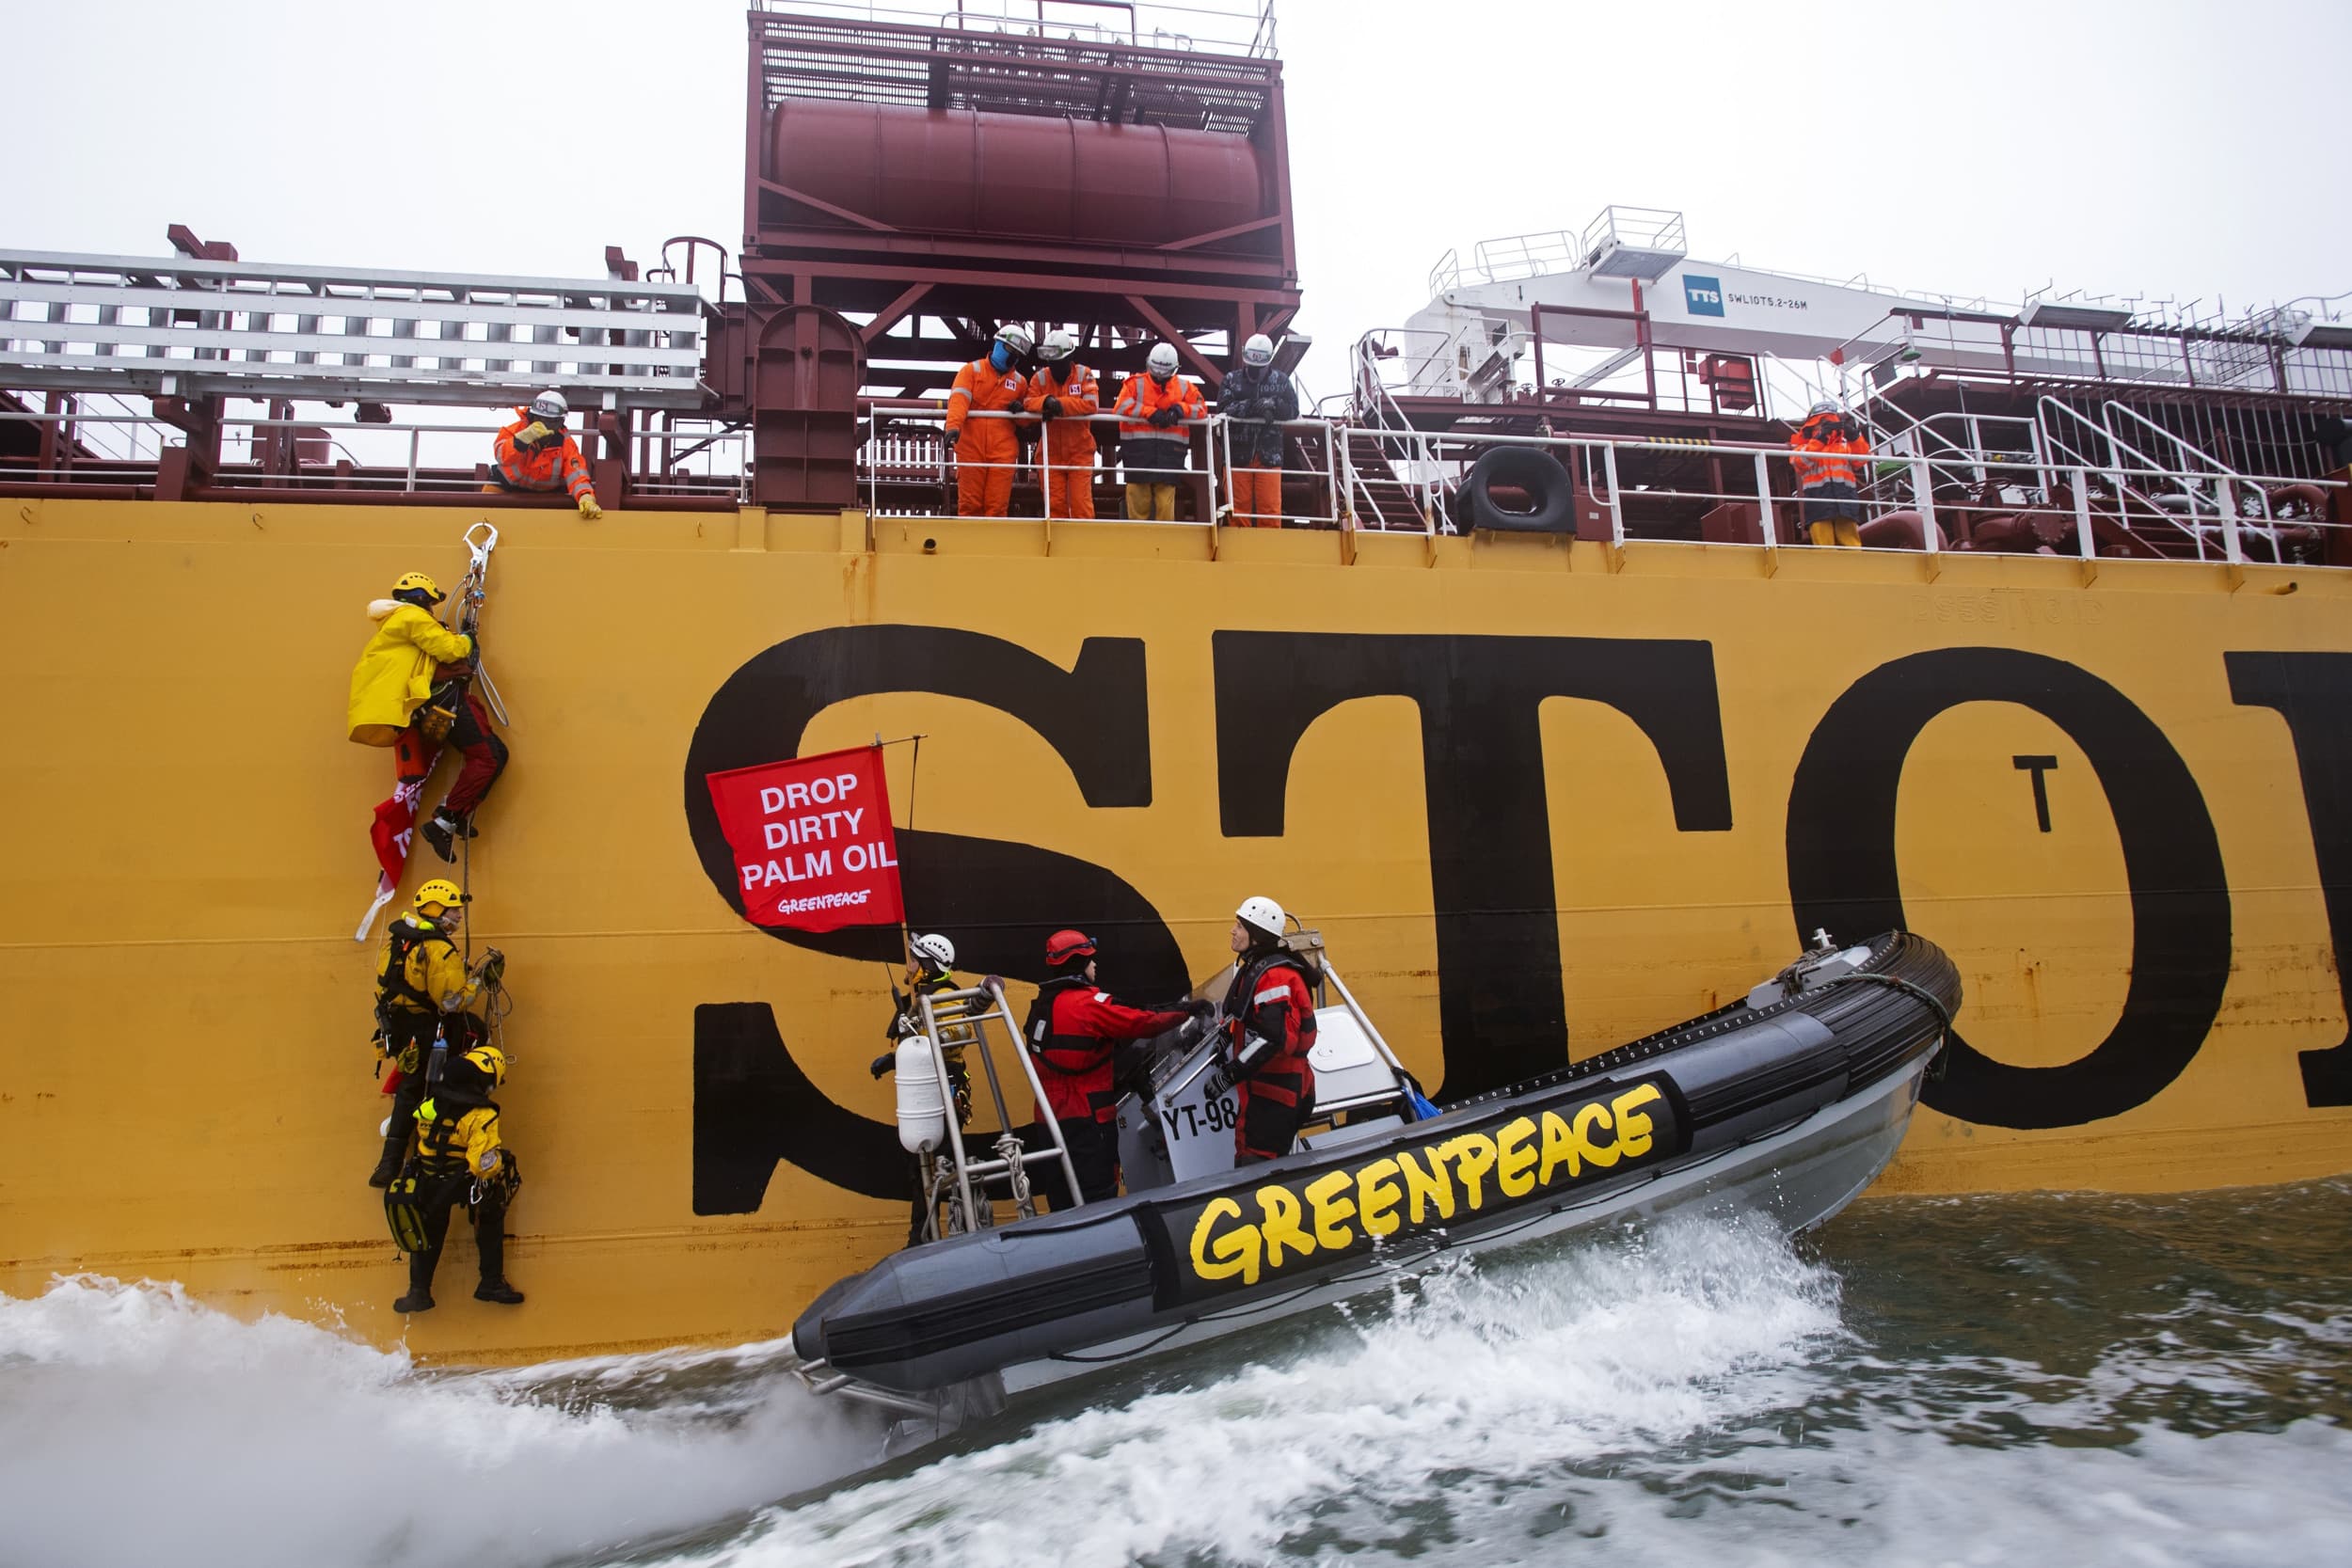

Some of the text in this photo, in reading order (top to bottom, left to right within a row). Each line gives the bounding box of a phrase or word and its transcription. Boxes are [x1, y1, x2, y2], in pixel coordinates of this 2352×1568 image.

[1688, 289, 1720, 304] TTS
[760, 773, 858, 815] DROP
[2012, 755, 2058, 832] T
[764, 808, 864, 850] DIRTY
[741, 841, 898, 890] PALM OIL
[778, 889, 871, 915] GREENPEACE
[1190, 1084, 1661, 1285] GREENPEACE
